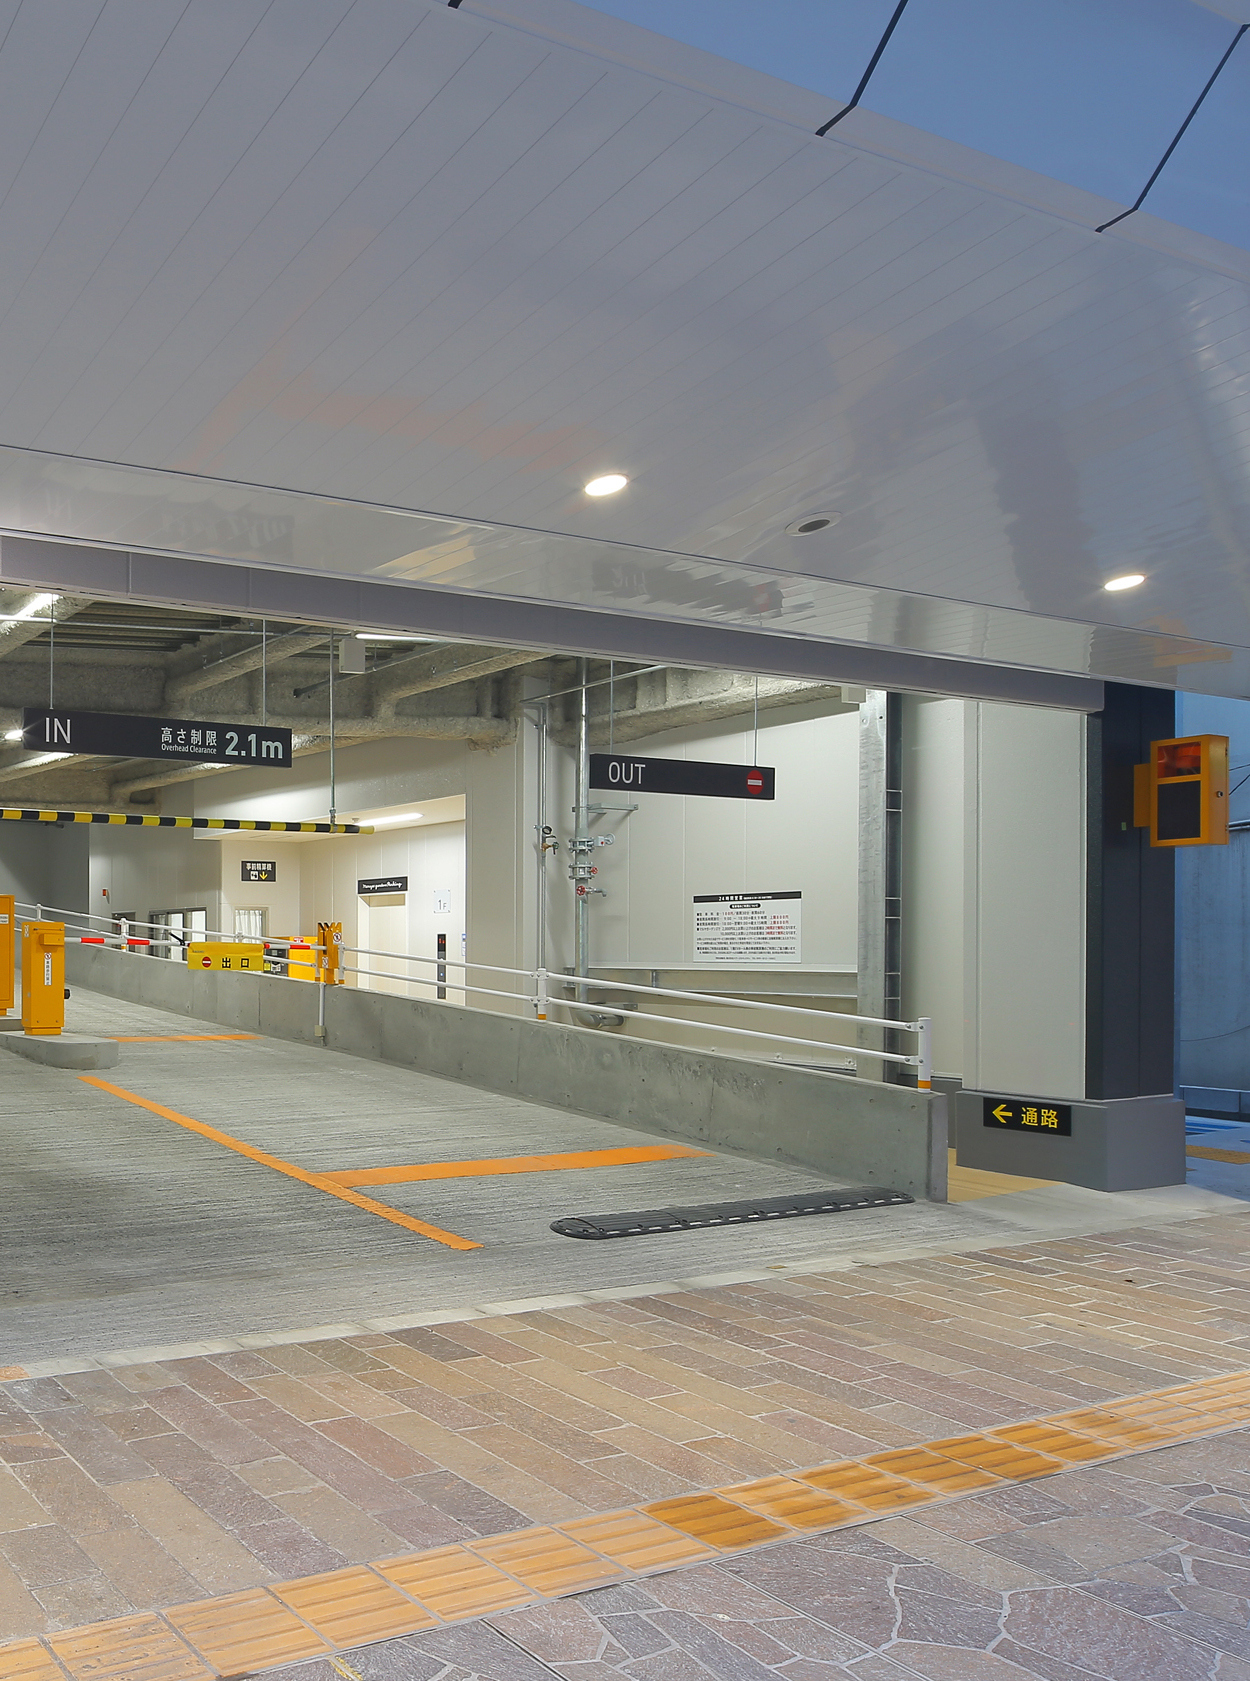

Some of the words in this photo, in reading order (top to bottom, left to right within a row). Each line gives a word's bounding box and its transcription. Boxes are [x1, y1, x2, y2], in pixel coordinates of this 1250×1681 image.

[45, 717, 71, 744] IN
[160, 727, 217, 747] 高さ制限
[225, 731, 283, 759] 2.1m
[161, 743, 189, 753] Overhead
[190, 745, 217, 755] Clearance
[608, 761, 646, 785] OUT
[221, 956, 249, 969] 出口
[1021, 1107, 1059, 1128] 通路
